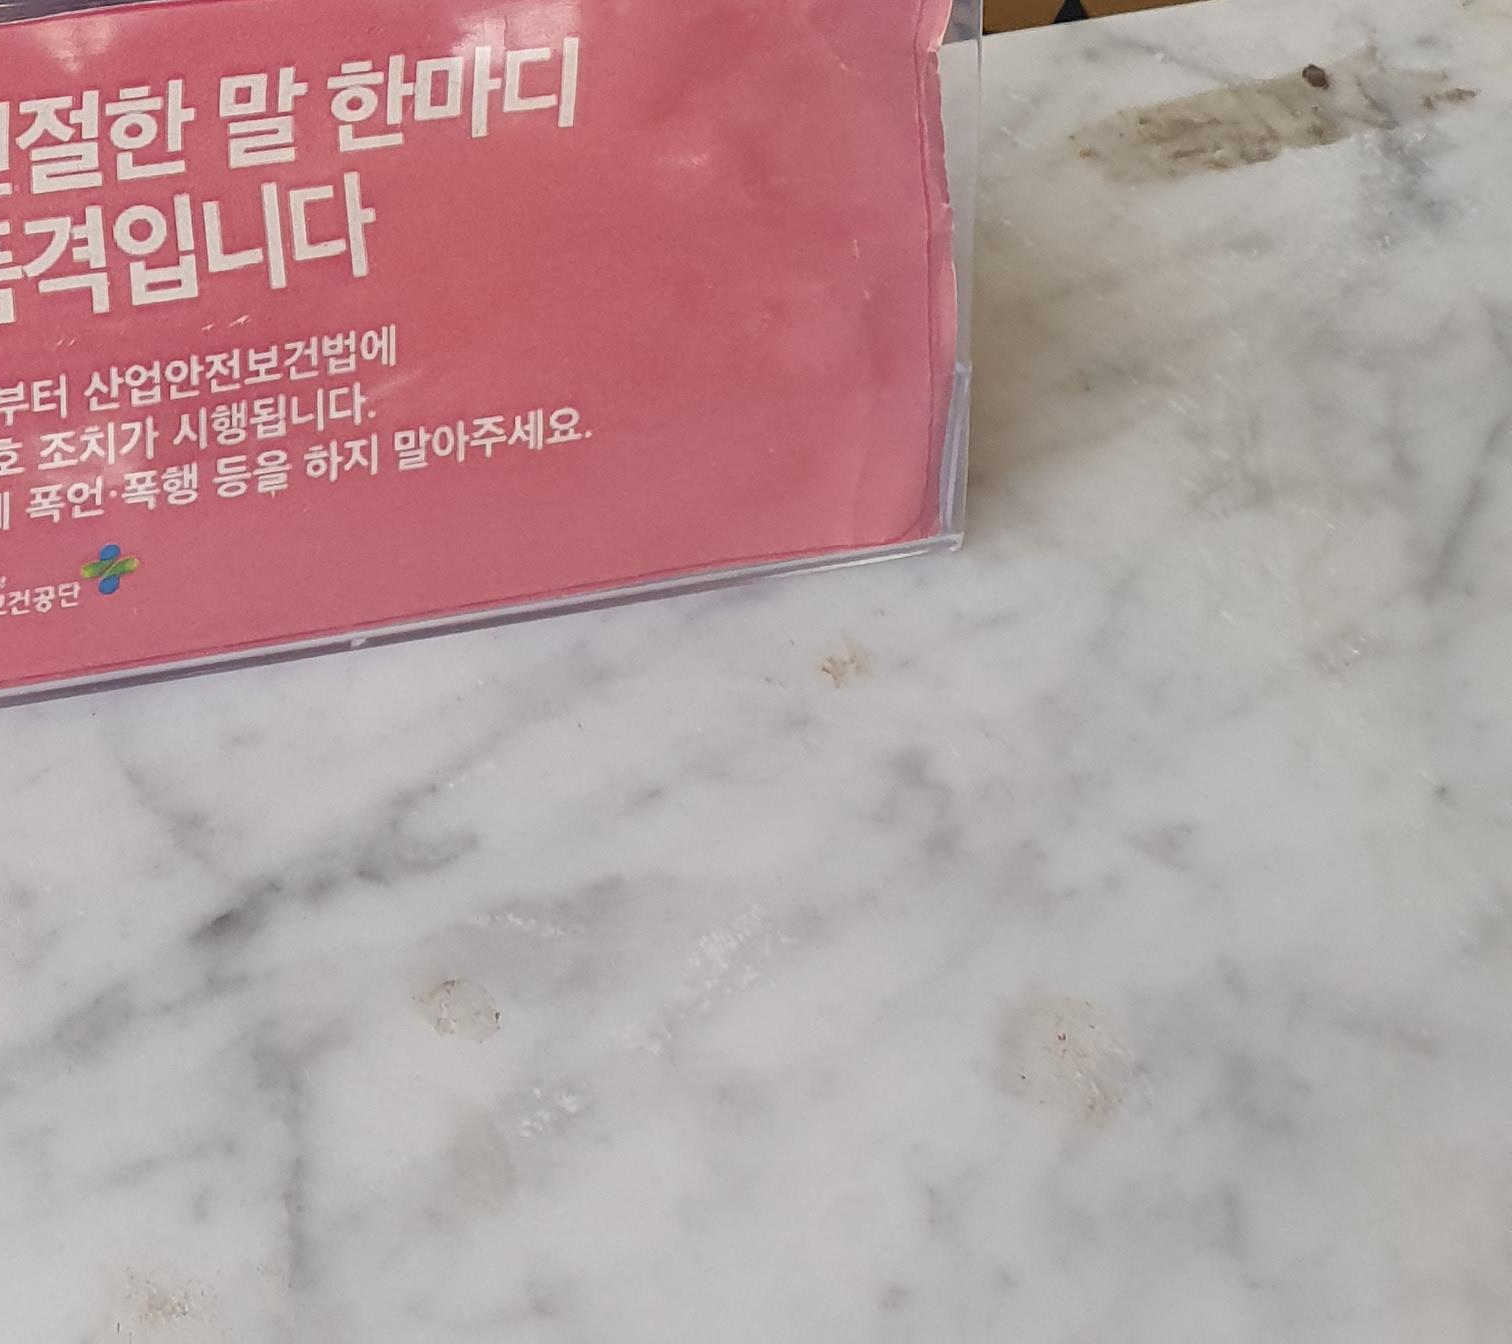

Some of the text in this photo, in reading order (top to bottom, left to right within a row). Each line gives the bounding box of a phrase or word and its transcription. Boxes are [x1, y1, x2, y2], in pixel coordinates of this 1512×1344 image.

[218, 70, 307, 169] 말
[326, 37, 581, 153] 한마디
[83, 323, 397, 412] 산업안전보건법에
[25, 462, 199, 520] 폭언·폭행
[212, 449, 291, 499] 등을
[303, 434, 379, 483] 하지
[393, 406, 593, 472] 말아주세요.
[37, 414, 159, 472] 조치가
[172, 382, 377, 450] 시행됩니다.
